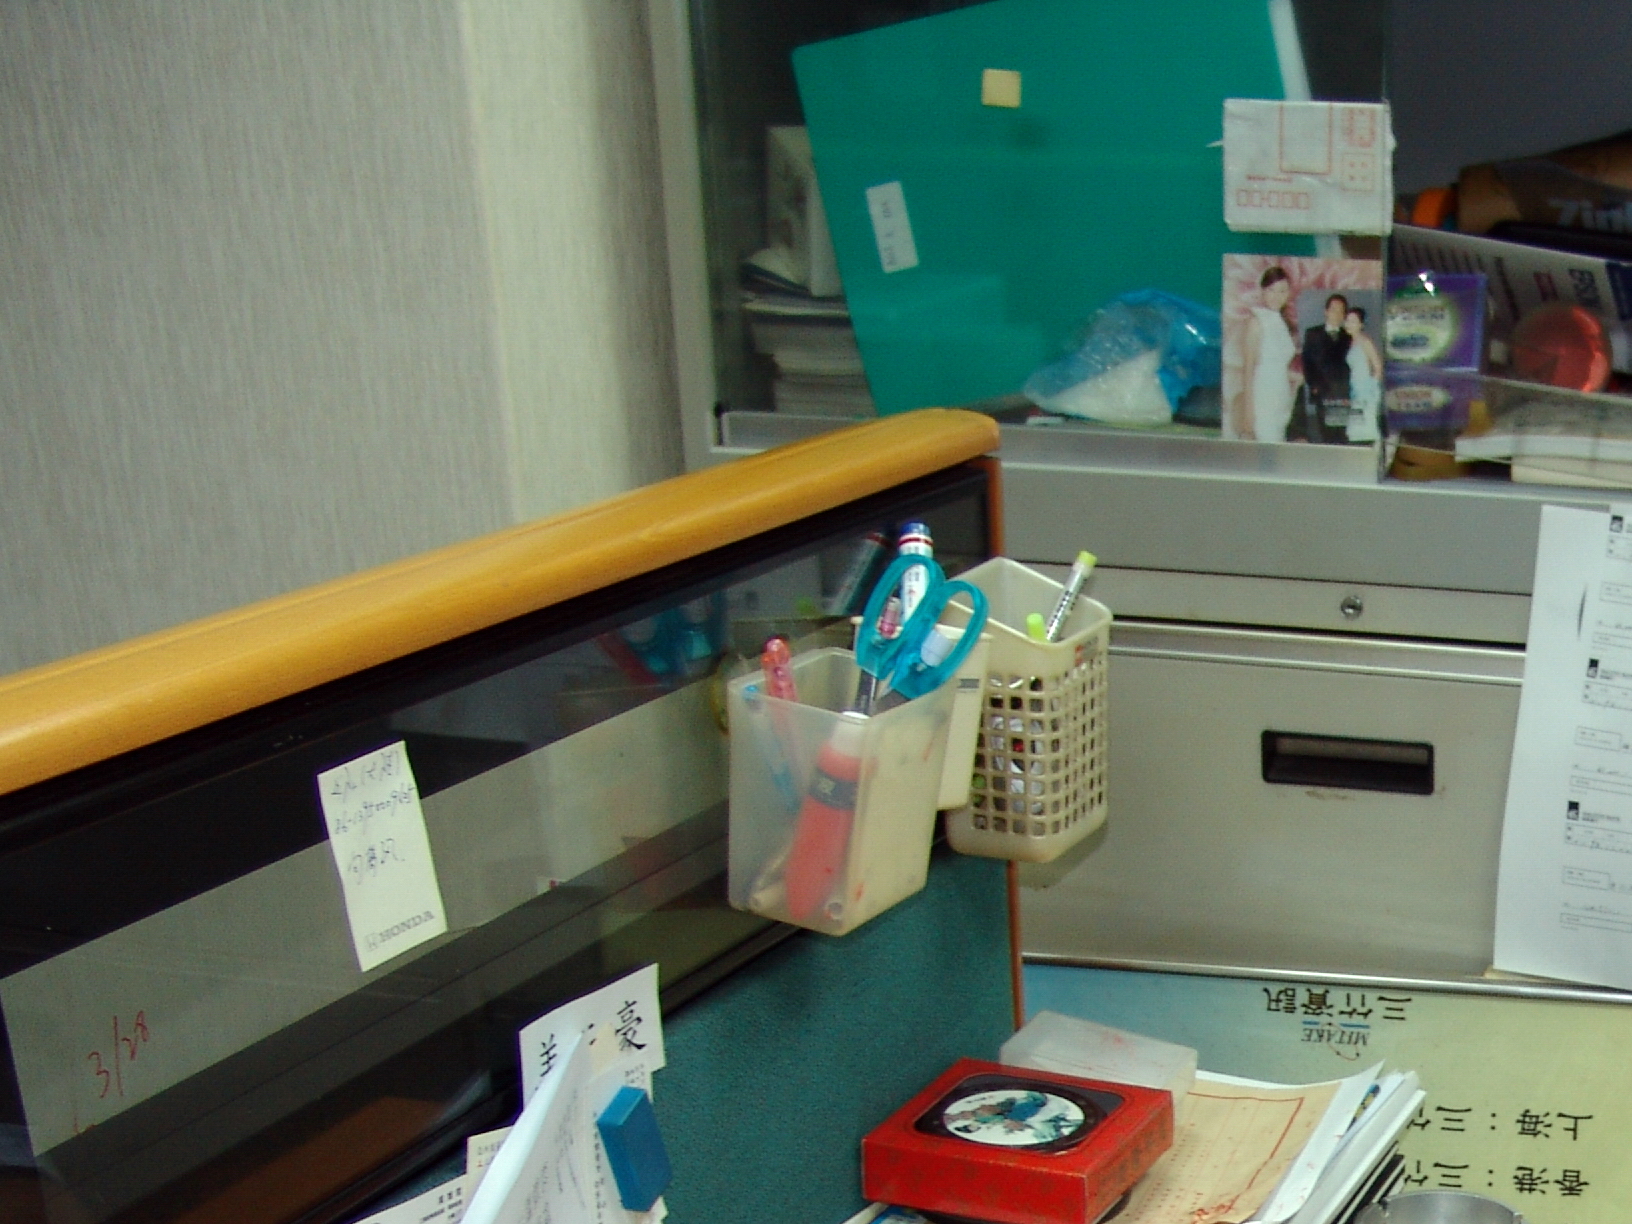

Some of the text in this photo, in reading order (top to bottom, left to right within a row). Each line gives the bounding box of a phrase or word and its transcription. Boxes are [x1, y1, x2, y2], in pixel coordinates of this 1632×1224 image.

[379, 910, 435, 945] HONDA
[1263, 987, 1412, 1021] 三竹資訊
[1301, 1027, 1369, 1047] MITAKE
